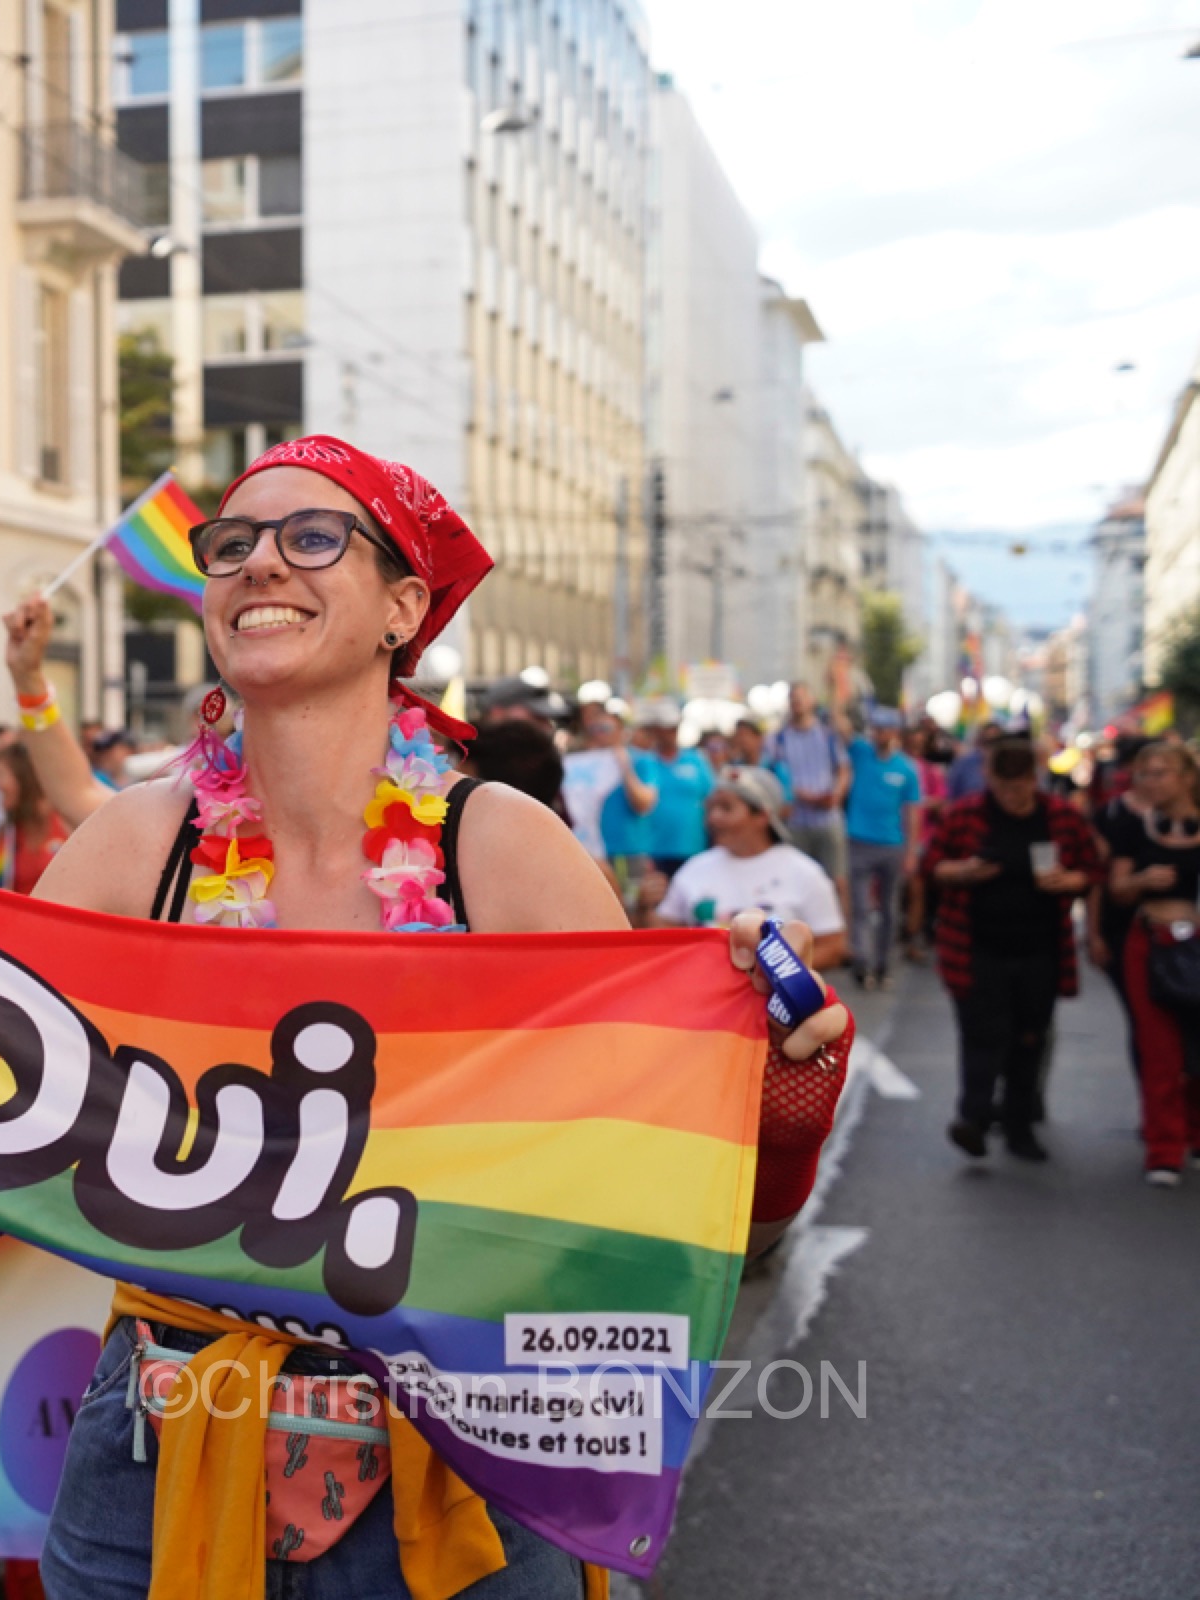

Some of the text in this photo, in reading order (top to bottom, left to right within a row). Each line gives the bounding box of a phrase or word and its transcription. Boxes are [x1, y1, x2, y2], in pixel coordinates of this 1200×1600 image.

[522, 1326, 672, 1354] 26.09.2021
[465, 1389, 583, 1423] mariage
[590, 1389, 644, 1417] civil
[538, 1432, 567, 1456] et
[574, 1432, 631, 1457] tous
